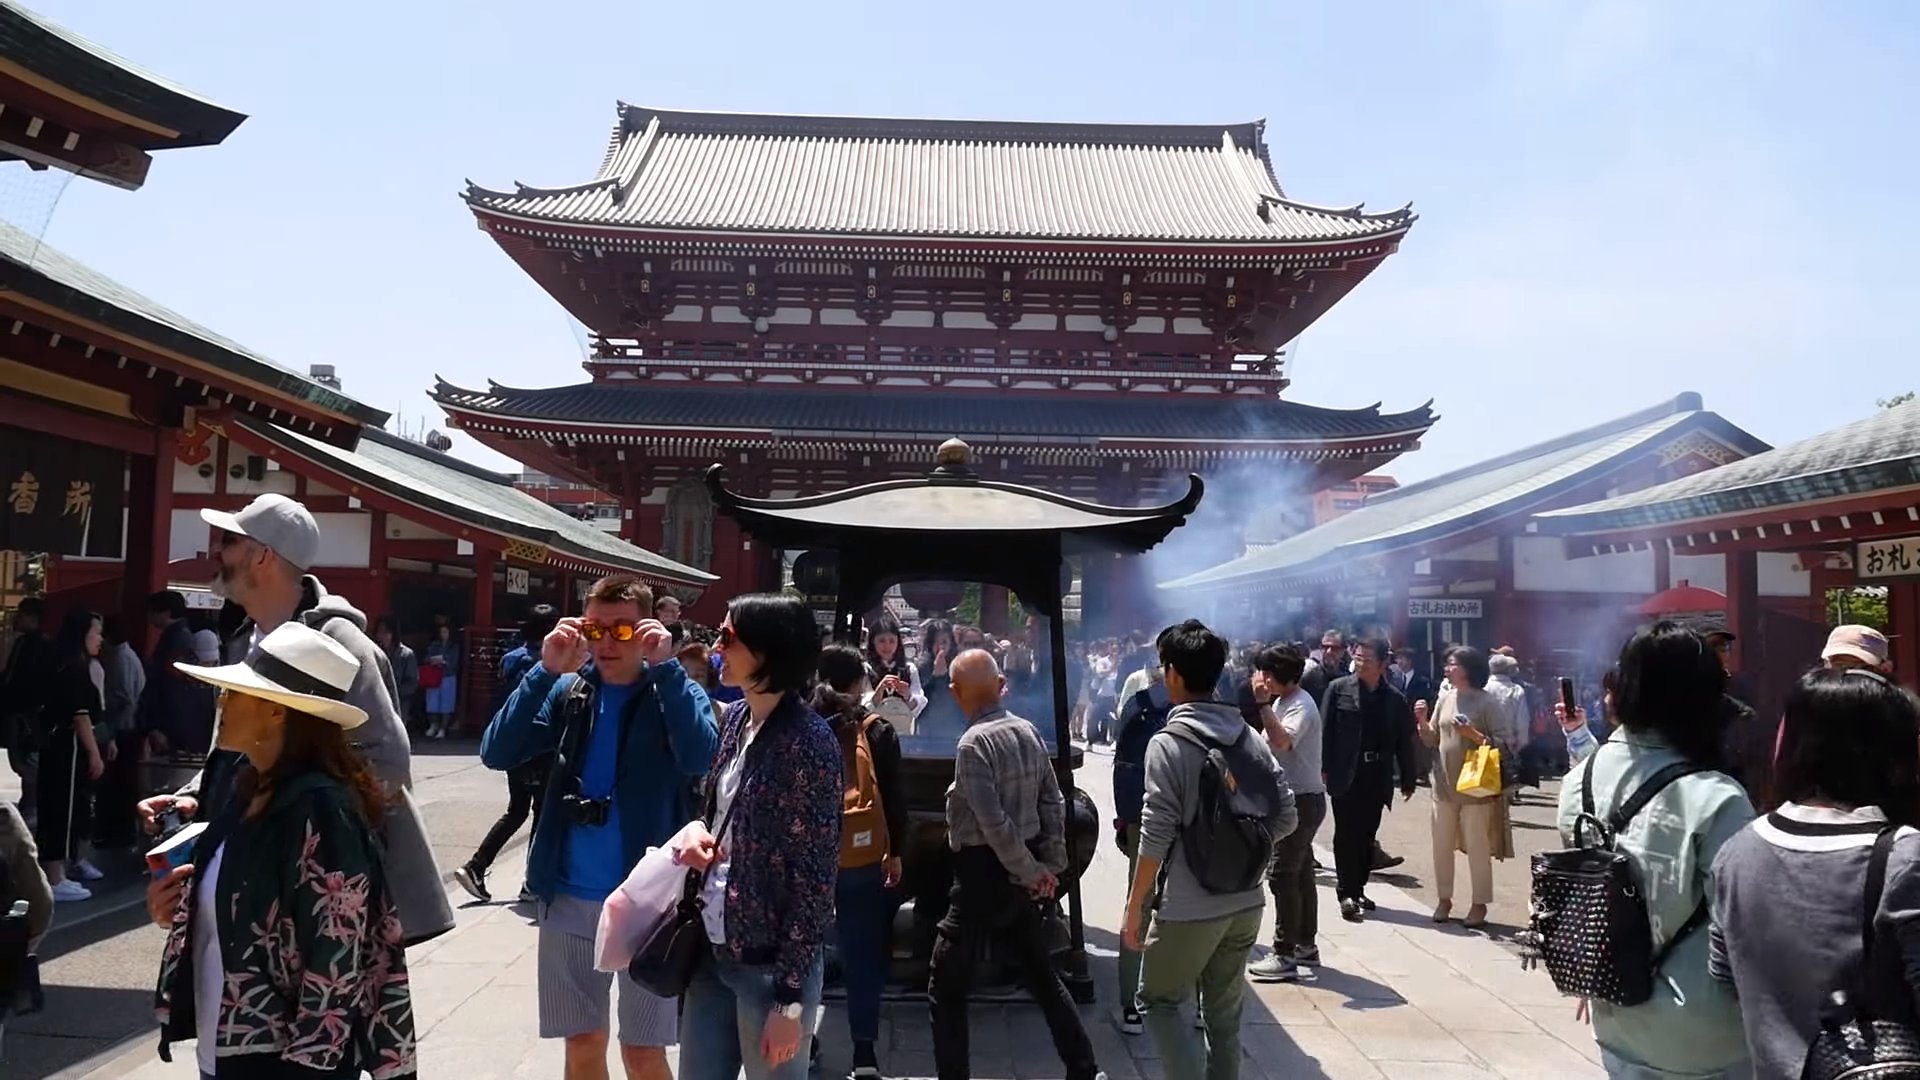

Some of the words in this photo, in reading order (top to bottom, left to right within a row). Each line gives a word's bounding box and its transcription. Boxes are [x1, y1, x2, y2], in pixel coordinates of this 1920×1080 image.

[1867, 543, 1920, 574] お札
[1409, 601, 1479, 615] 古札お納め所
